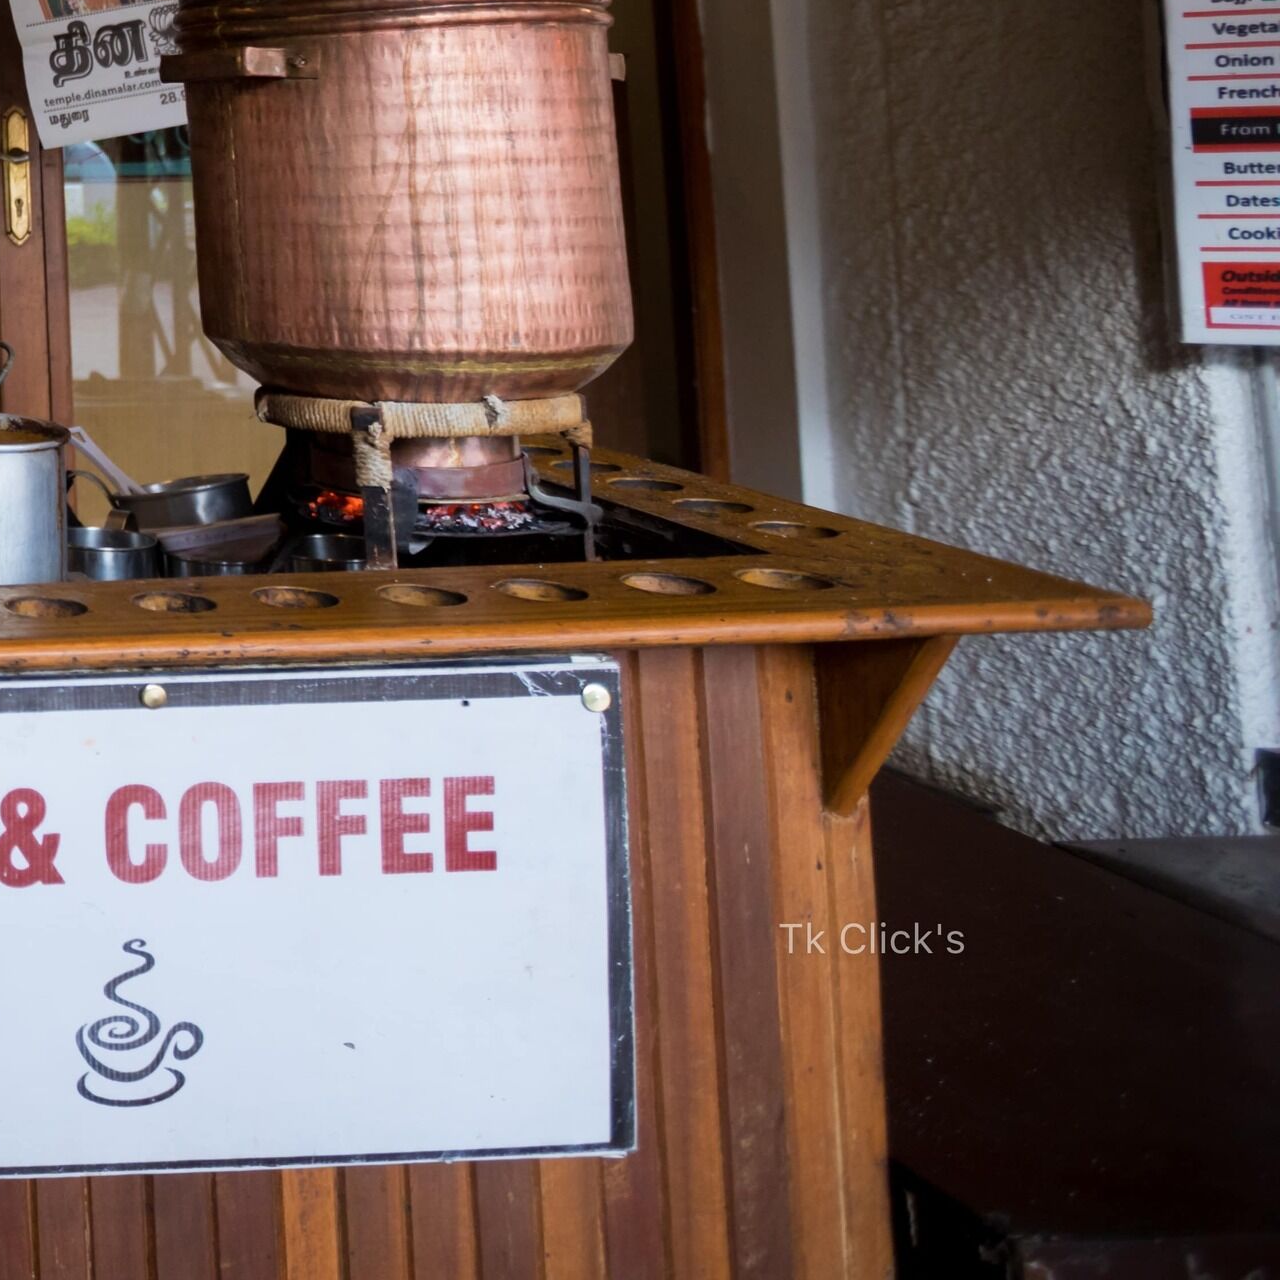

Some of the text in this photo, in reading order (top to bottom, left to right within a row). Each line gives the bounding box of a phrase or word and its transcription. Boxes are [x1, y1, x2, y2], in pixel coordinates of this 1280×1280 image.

[1215, 55, 1274, 68] Onion
[44, 79, 161, 107] temple.dinamalar.com
[1218, 86, 1280, 99] French
[49, 108, 89, 128] மதுரை
[1221, 123, 1270, 136] From
[1226, 195, 1280, 207] Dates
[104, 775, 497, 884] COFFEE
